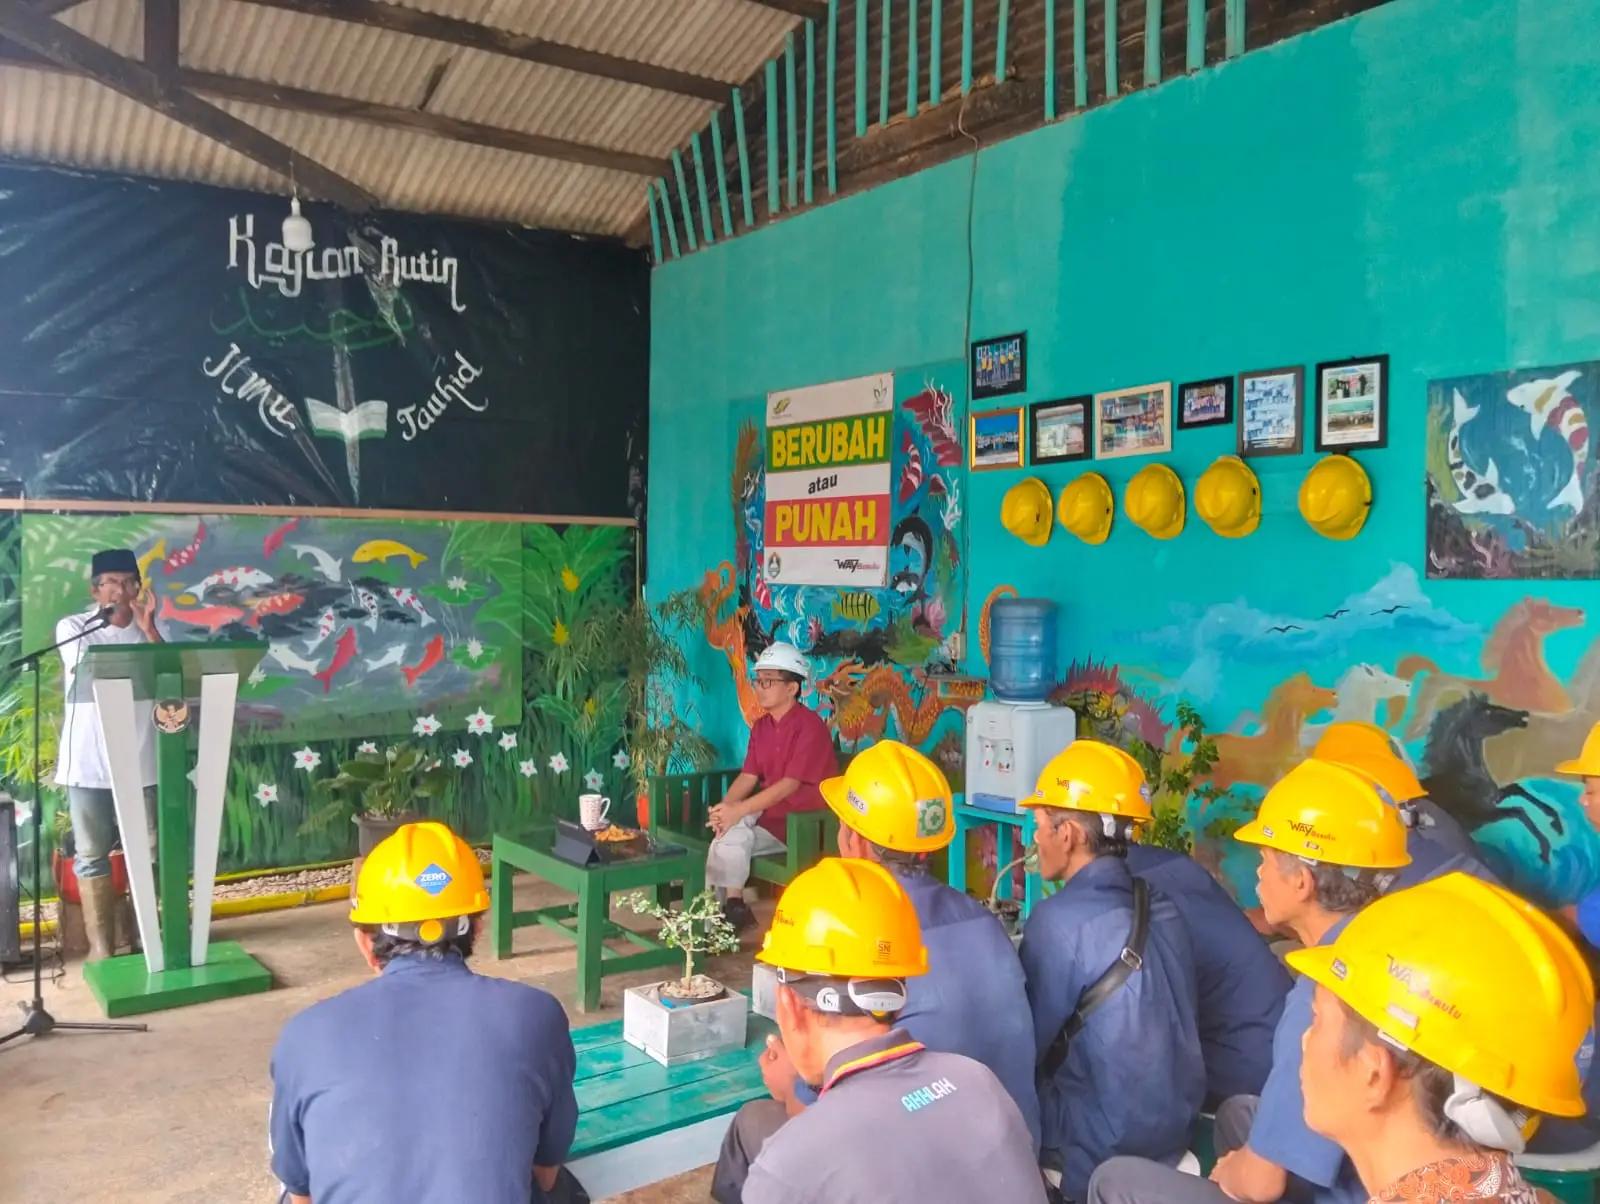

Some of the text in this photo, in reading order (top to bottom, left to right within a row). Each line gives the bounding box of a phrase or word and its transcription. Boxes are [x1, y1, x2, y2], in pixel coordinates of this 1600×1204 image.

[381, 236, 467, 312] Rutin
[397, 350, 488, 441] Tauhid
[772, 416, 885, 467] BERUBAH
[808, 473, 838, 494] atau
[775, 500, 876, 542] PUNAH
[834, 558, 859, 573] WAY
[1288, 819, 1315, 836] WAY
